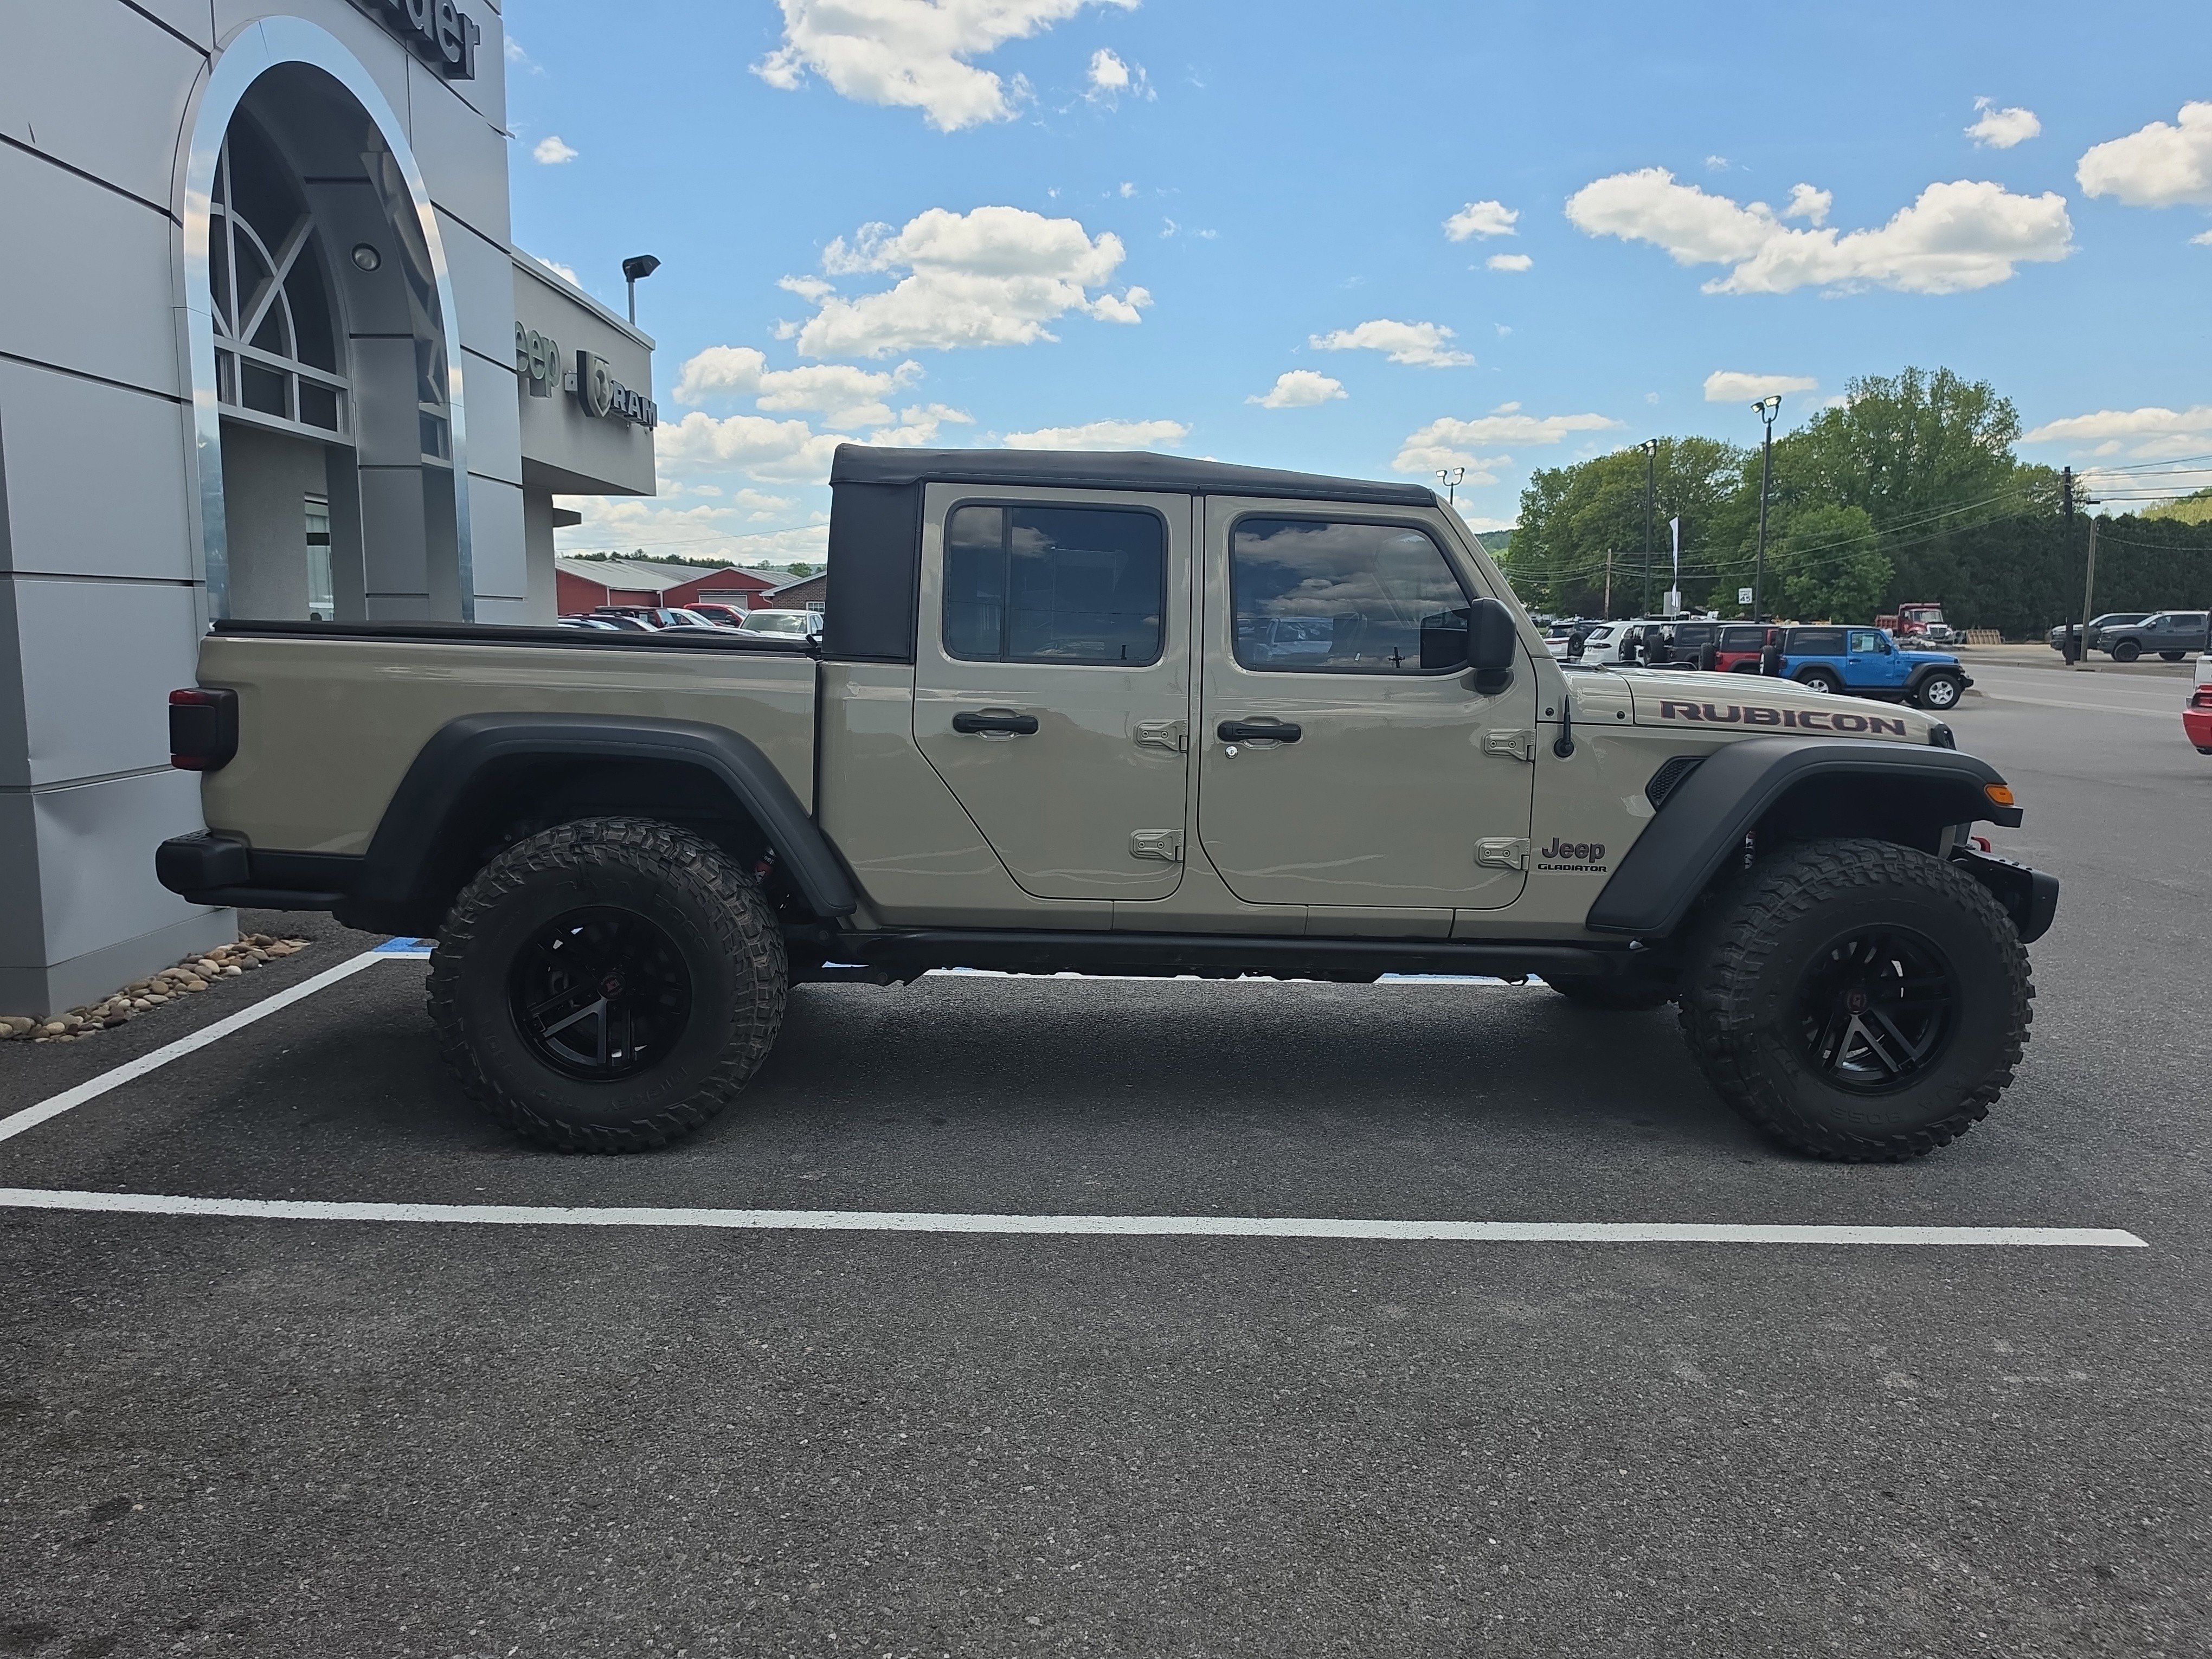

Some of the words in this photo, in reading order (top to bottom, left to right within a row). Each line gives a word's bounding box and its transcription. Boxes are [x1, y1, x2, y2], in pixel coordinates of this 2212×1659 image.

[515, 320, 562, 398] eep
[613, 380, 658, 427] RAM
[1660, 700, 1907, 737] RUBICON
[1538, 863, 1607, 872] GLADIATOR
[1541, 837, 1605, 863] Jeep
